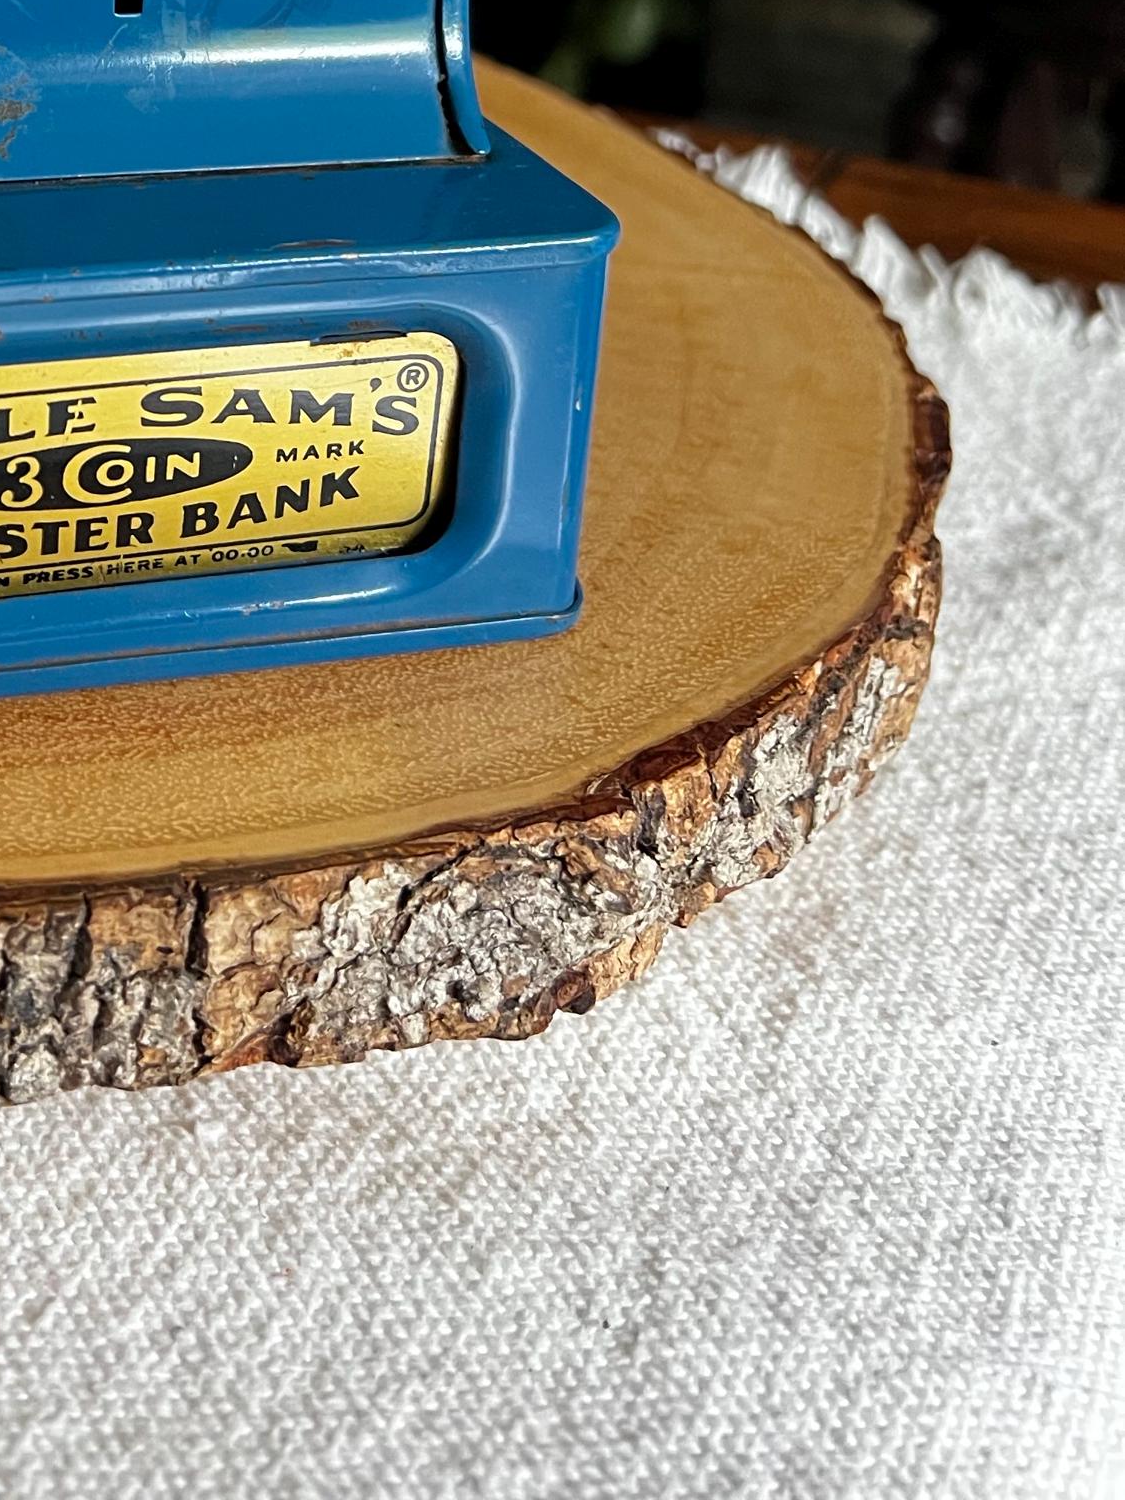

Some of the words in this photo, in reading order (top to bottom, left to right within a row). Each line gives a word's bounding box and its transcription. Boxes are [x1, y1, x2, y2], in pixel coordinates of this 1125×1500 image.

[276, 439, 364, 463] MARK
[0, 456, 44, 508] 3
[62, 444, 201, 504] COIN
[179, 466, 360, 538] BANK
[23, 566, 94, 585] PRESS
[106, 558, 164, 575] HERE
[174, 554, 202, 567] AT
